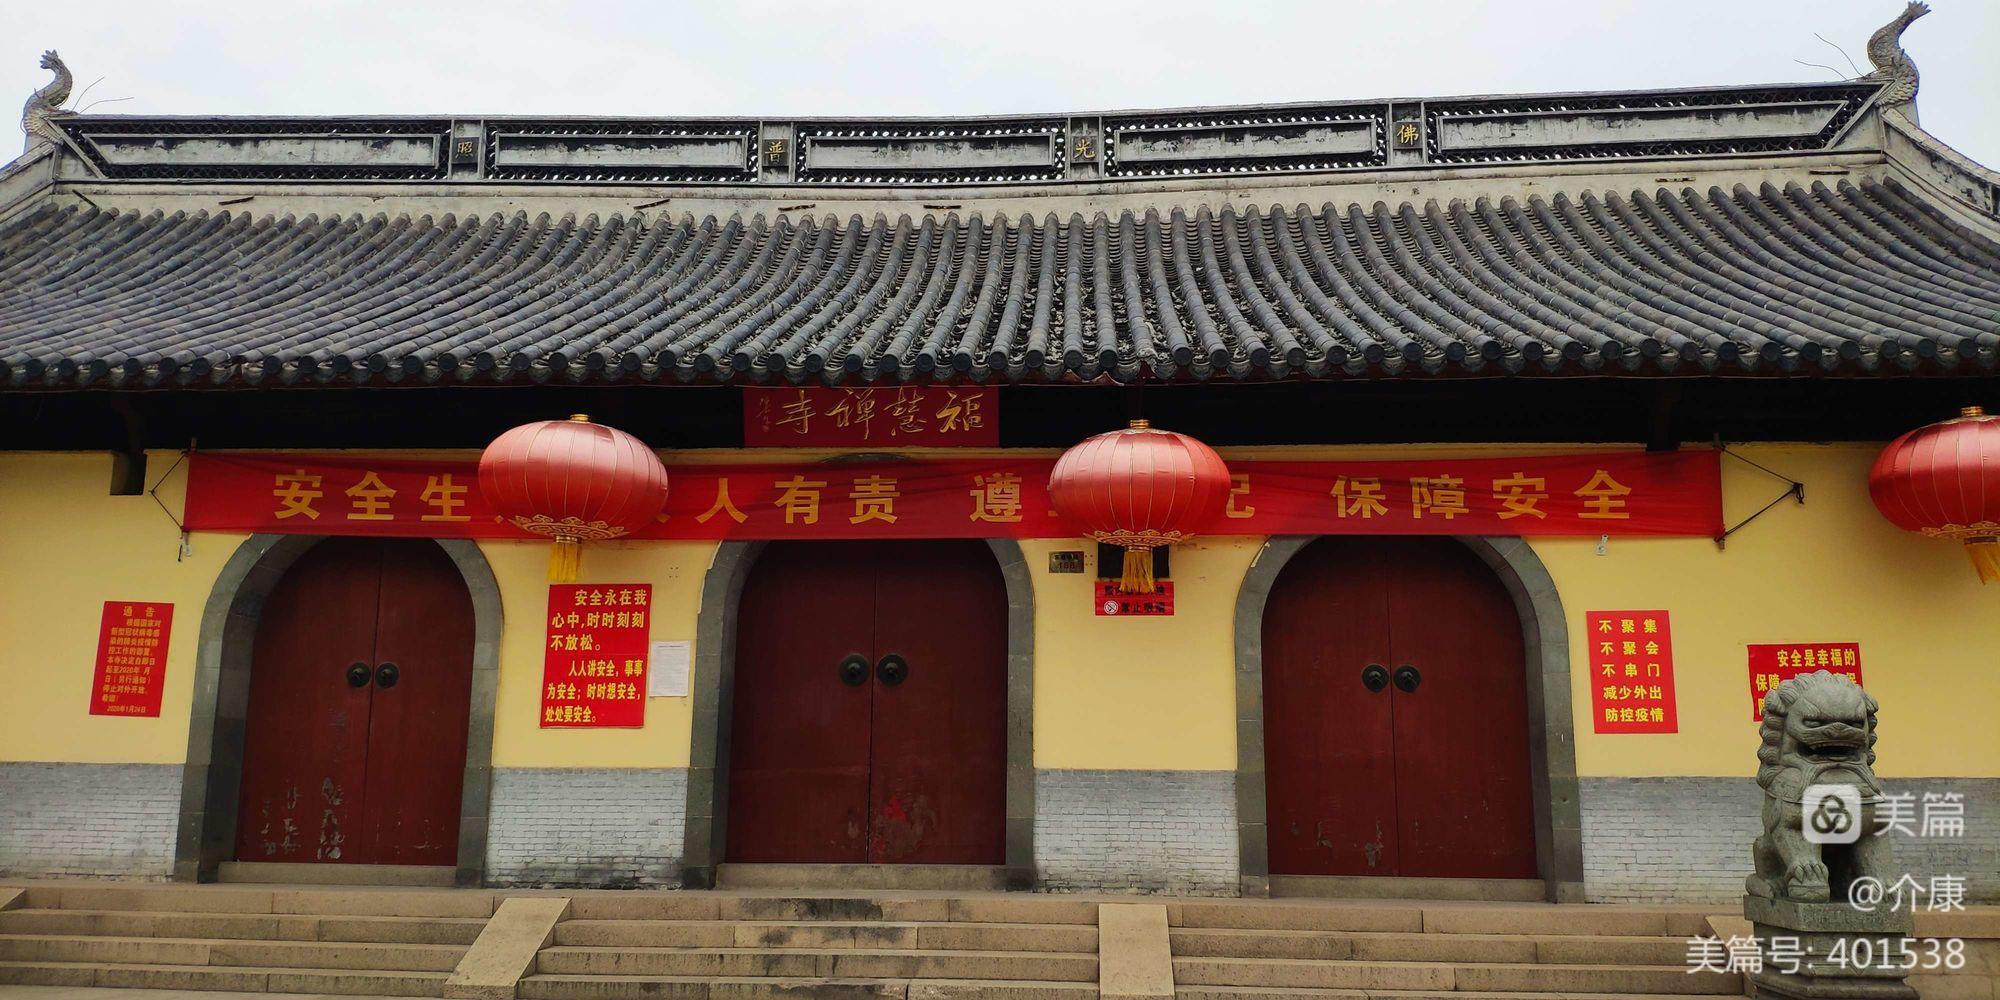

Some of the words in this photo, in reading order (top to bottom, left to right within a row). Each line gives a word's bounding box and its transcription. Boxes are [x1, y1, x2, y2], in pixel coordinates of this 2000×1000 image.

[1396, 123, 1420, 147] 佛
[456, 140, 475, 159] 照
[764, 141, 786, 164] 普
[1073, 138, 1097, 160] 光
[272, 469, 505, 523] 安全生
[655, 474, 900, 525] 人有责
[1329, 469, 1633, 521] 保障安全
[574, 589, 647, 606] 安全永在我
[1598, 618, 1658, 634] 不聚集
[550, 633, 601, 652] 不放松。
[1600, 641, 1660, 656] 不聚会
[1777, 648, 1856, 668] 安全是幸福的
[1602, 662, 1661, 678] 不串门
[1603, 685, 1663, 701] 减少外出
[544, 705, 597, 723] 处处要安全。
[1605, 707, 1665, 723] 防控疫情
